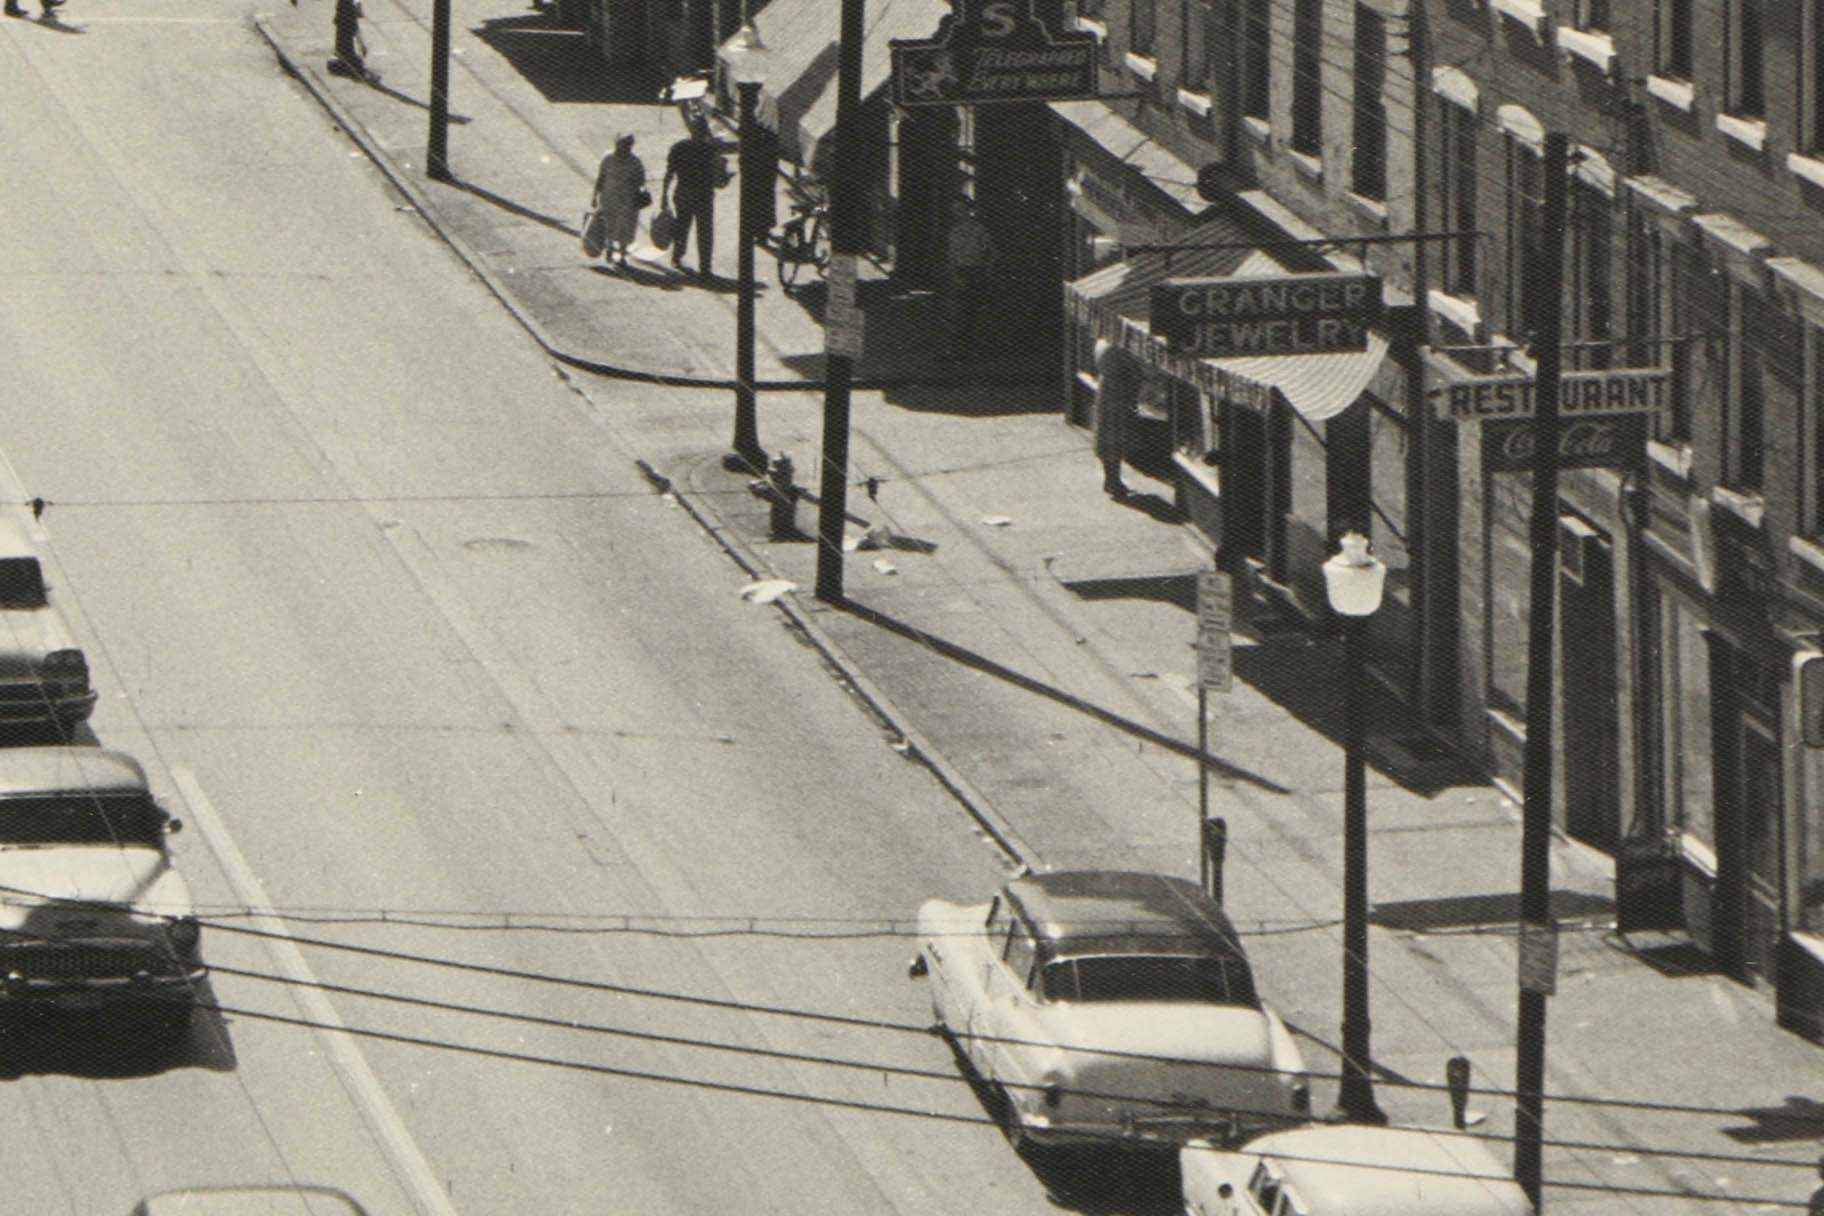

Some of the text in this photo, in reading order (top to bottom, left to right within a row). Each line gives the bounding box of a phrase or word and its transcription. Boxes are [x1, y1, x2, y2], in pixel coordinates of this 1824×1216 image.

[1178, 284, 1367, 315] GRANGER
[1182, 318, 1368, 353] JEWELRY
[1450, 380, 1664, 417] RESTURANT
